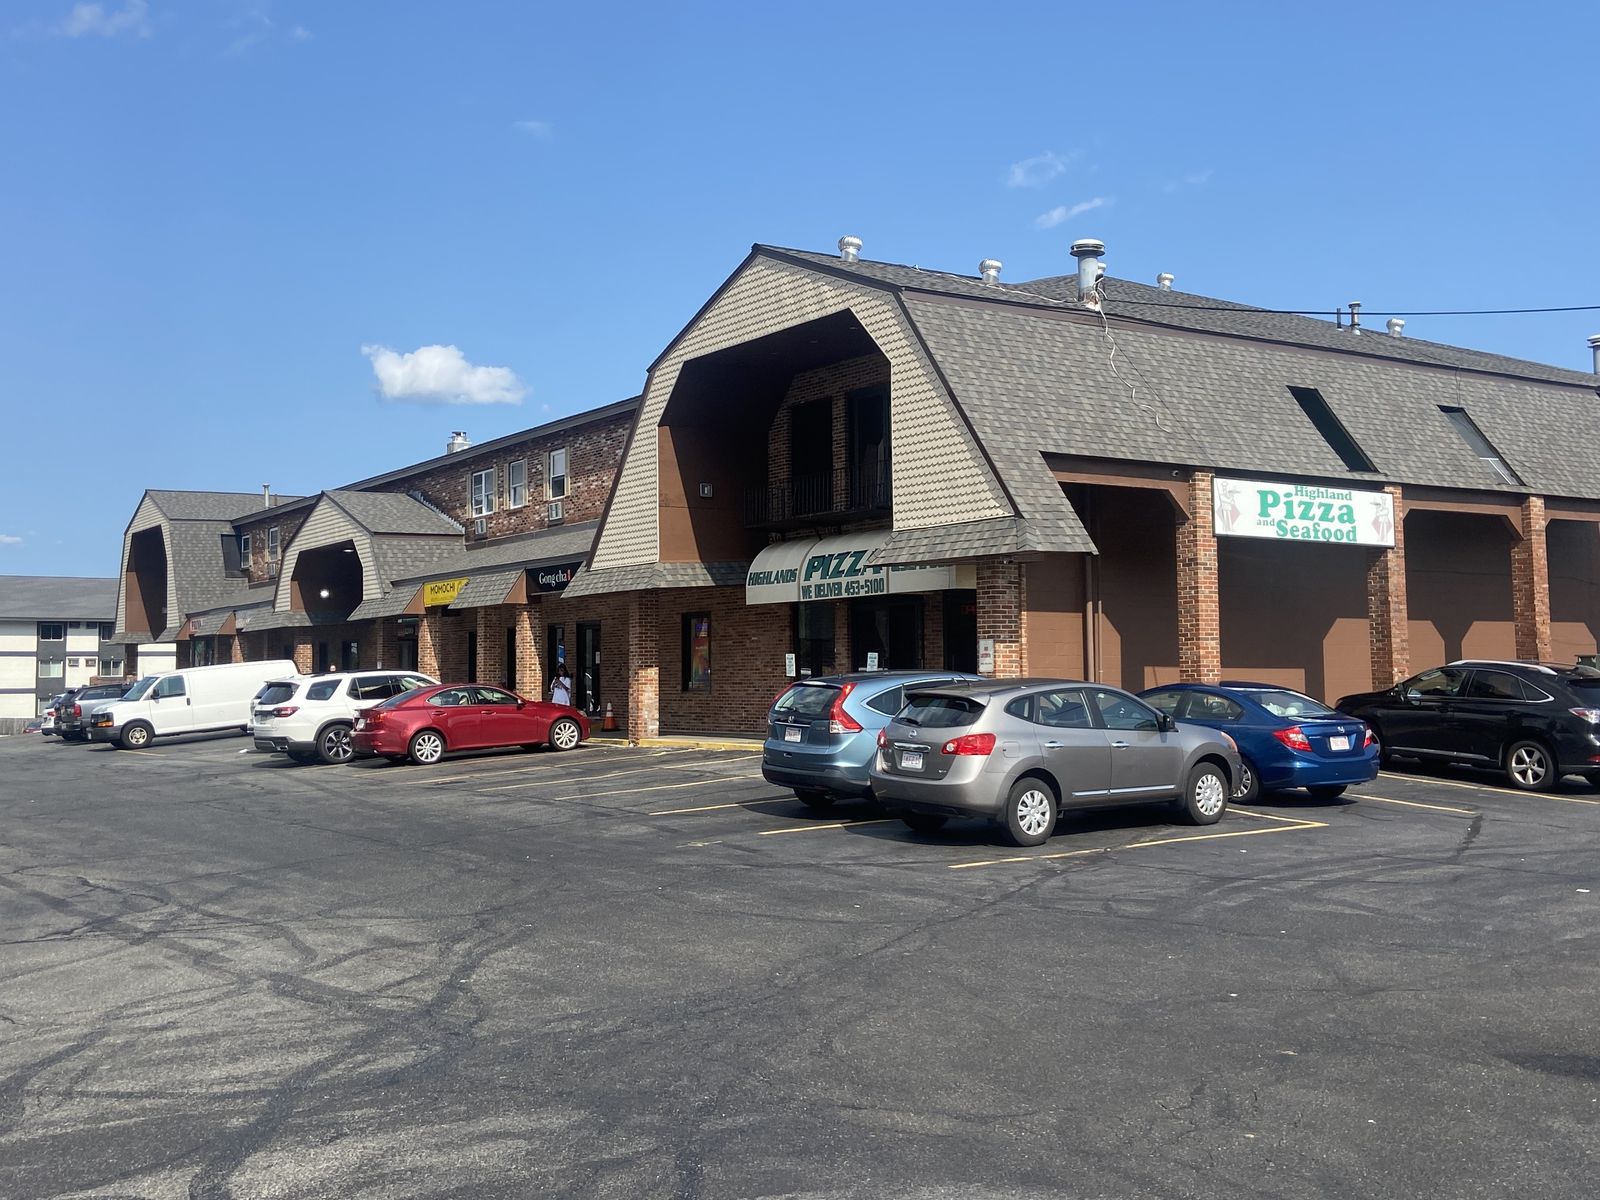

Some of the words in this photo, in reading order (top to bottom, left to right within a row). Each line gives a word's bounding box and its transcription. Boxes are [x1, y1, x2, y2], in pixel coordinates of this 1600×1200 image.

[1294, 485, 1352, 501] Highland
[1257, 490, 1356, 524] Pizza
[1276, 520, 1357, 542] Seafood
[538, 572, 556, 587] Gong
[556, 570, 567, 582] cha
[748, 568, 798, 586] HIGHLANDS
[430, 582, 456, 596] MOMOCHI
[801, 584, 813, 600] WE
[815, 581, 843, 598] DELIVER
[845, 578, 885, 596] 453-5100
